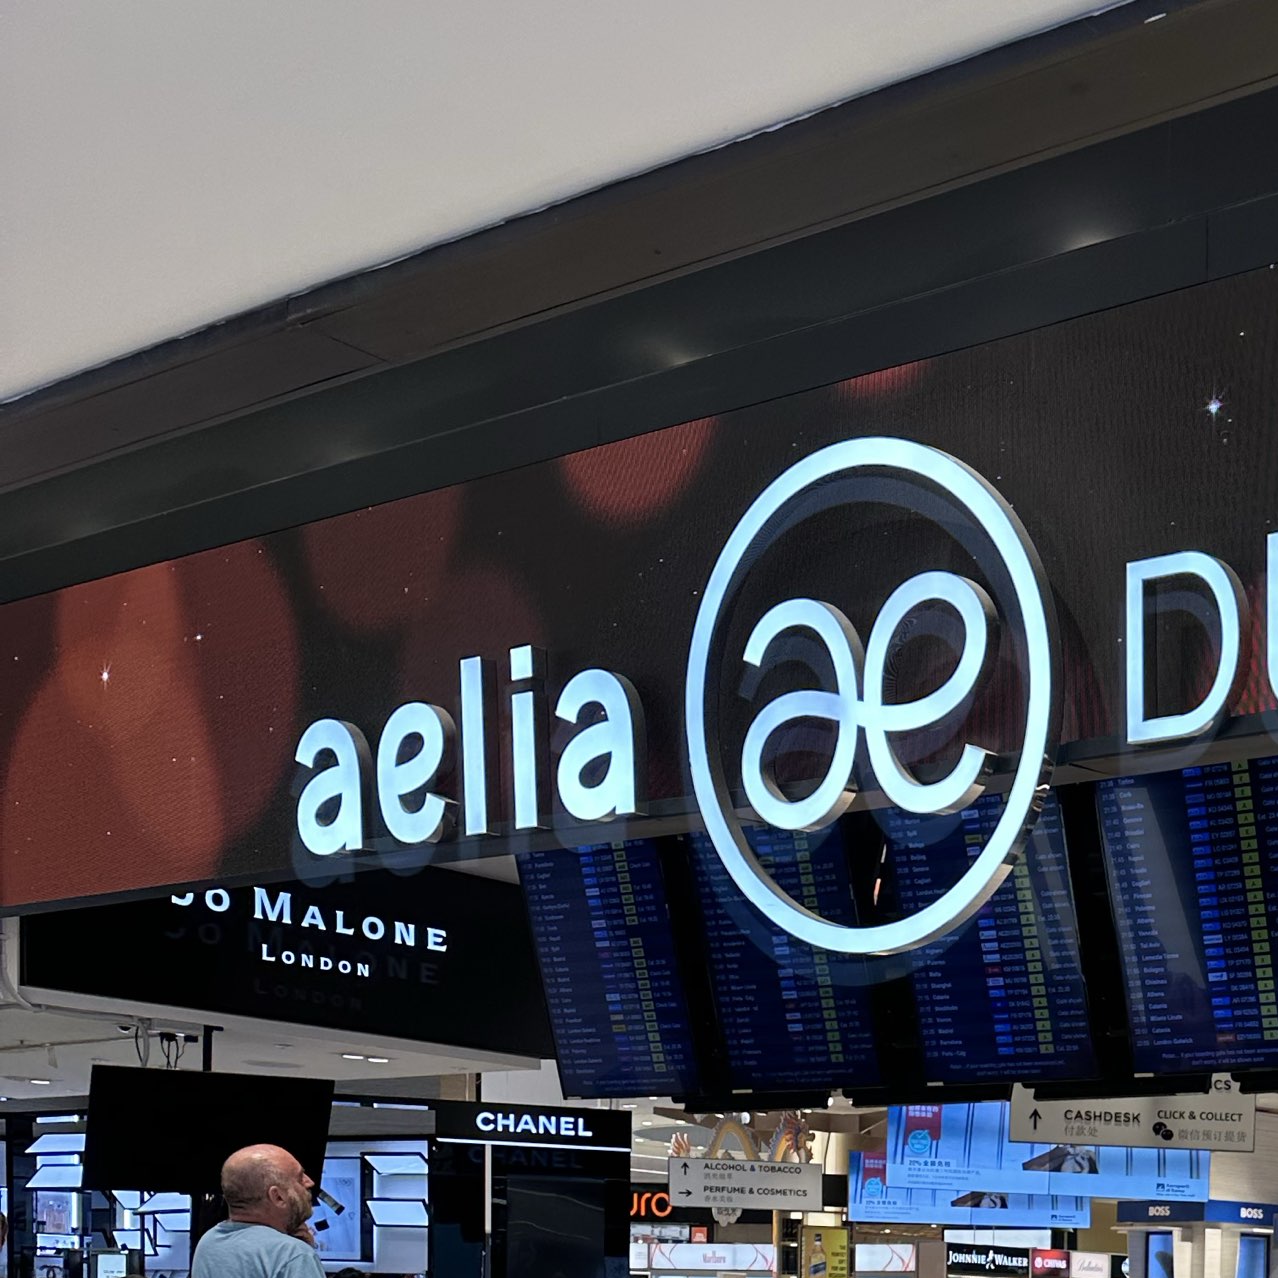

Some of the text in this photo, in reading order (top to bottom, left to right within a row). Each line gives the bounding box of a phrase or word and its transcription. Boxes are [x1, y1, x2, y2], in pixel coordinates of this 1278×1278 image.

[295, 645, 645, 857] aelia
[1064, 1109, 1141, 1124] CASHDESK
[1157, 1109, 1243, 1123] CLICK & COLLECT
[476, 1110, 594, 1138] CHANEL
[703, 1163, 748, 1172] ALCOHOL
[758, 1165, 802, 1175] TOBACCO
[703, 1185, 808, 1197] PERFUME & COSMETICS
[1148, 1205, 1171, 1216] BOSS
[1240, 1207, 1264, 1220] BOSS
[947, 1249, 1029, 1268] JOHNNIE WALKER
